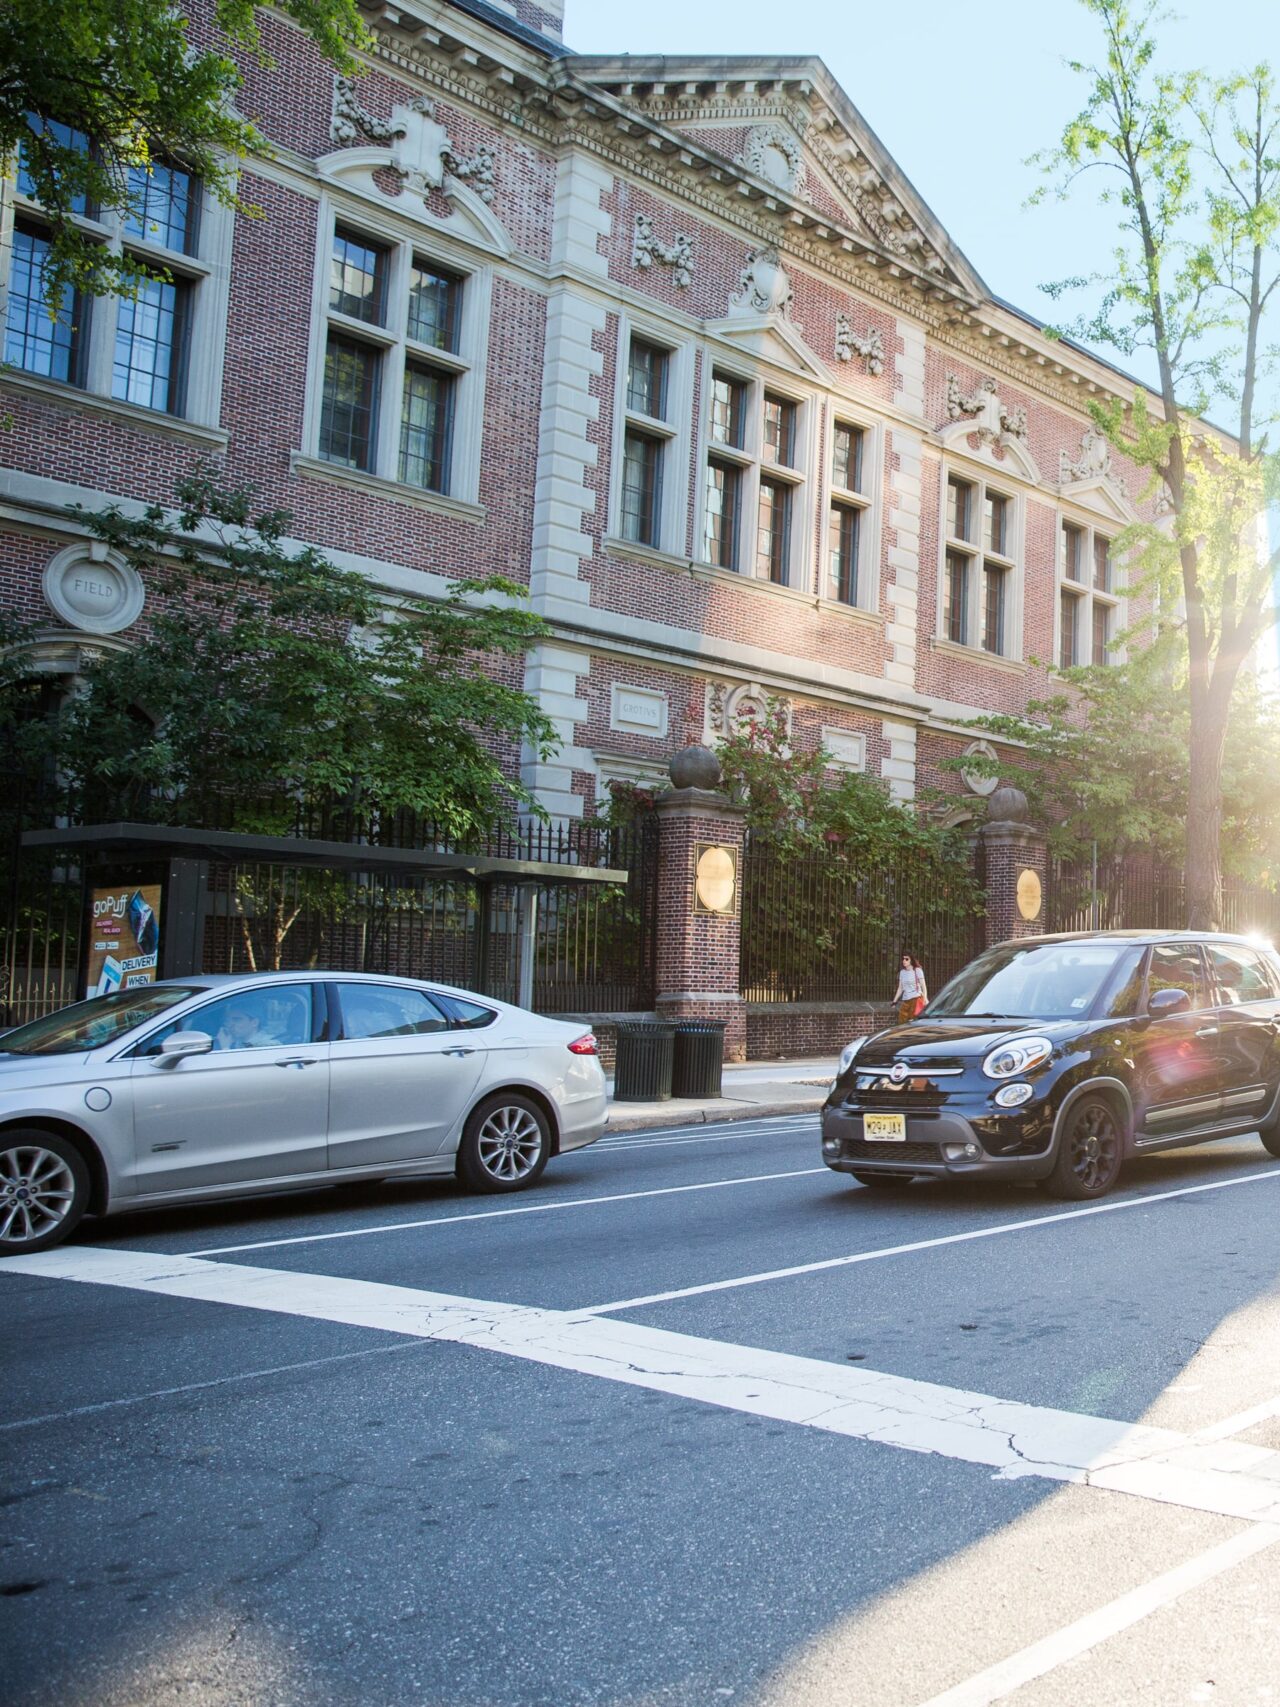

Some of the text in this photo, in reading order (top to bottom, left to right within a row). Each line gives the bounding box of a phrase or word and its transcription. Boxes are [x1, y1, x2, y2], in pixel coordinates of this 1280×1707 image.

[74, 579, 113, 597] FIELD
[93, 894, 128, 918] goPuff
[122, 955, 156, 971] DELIVERY
[128, 976, 150, 986] WHEN
